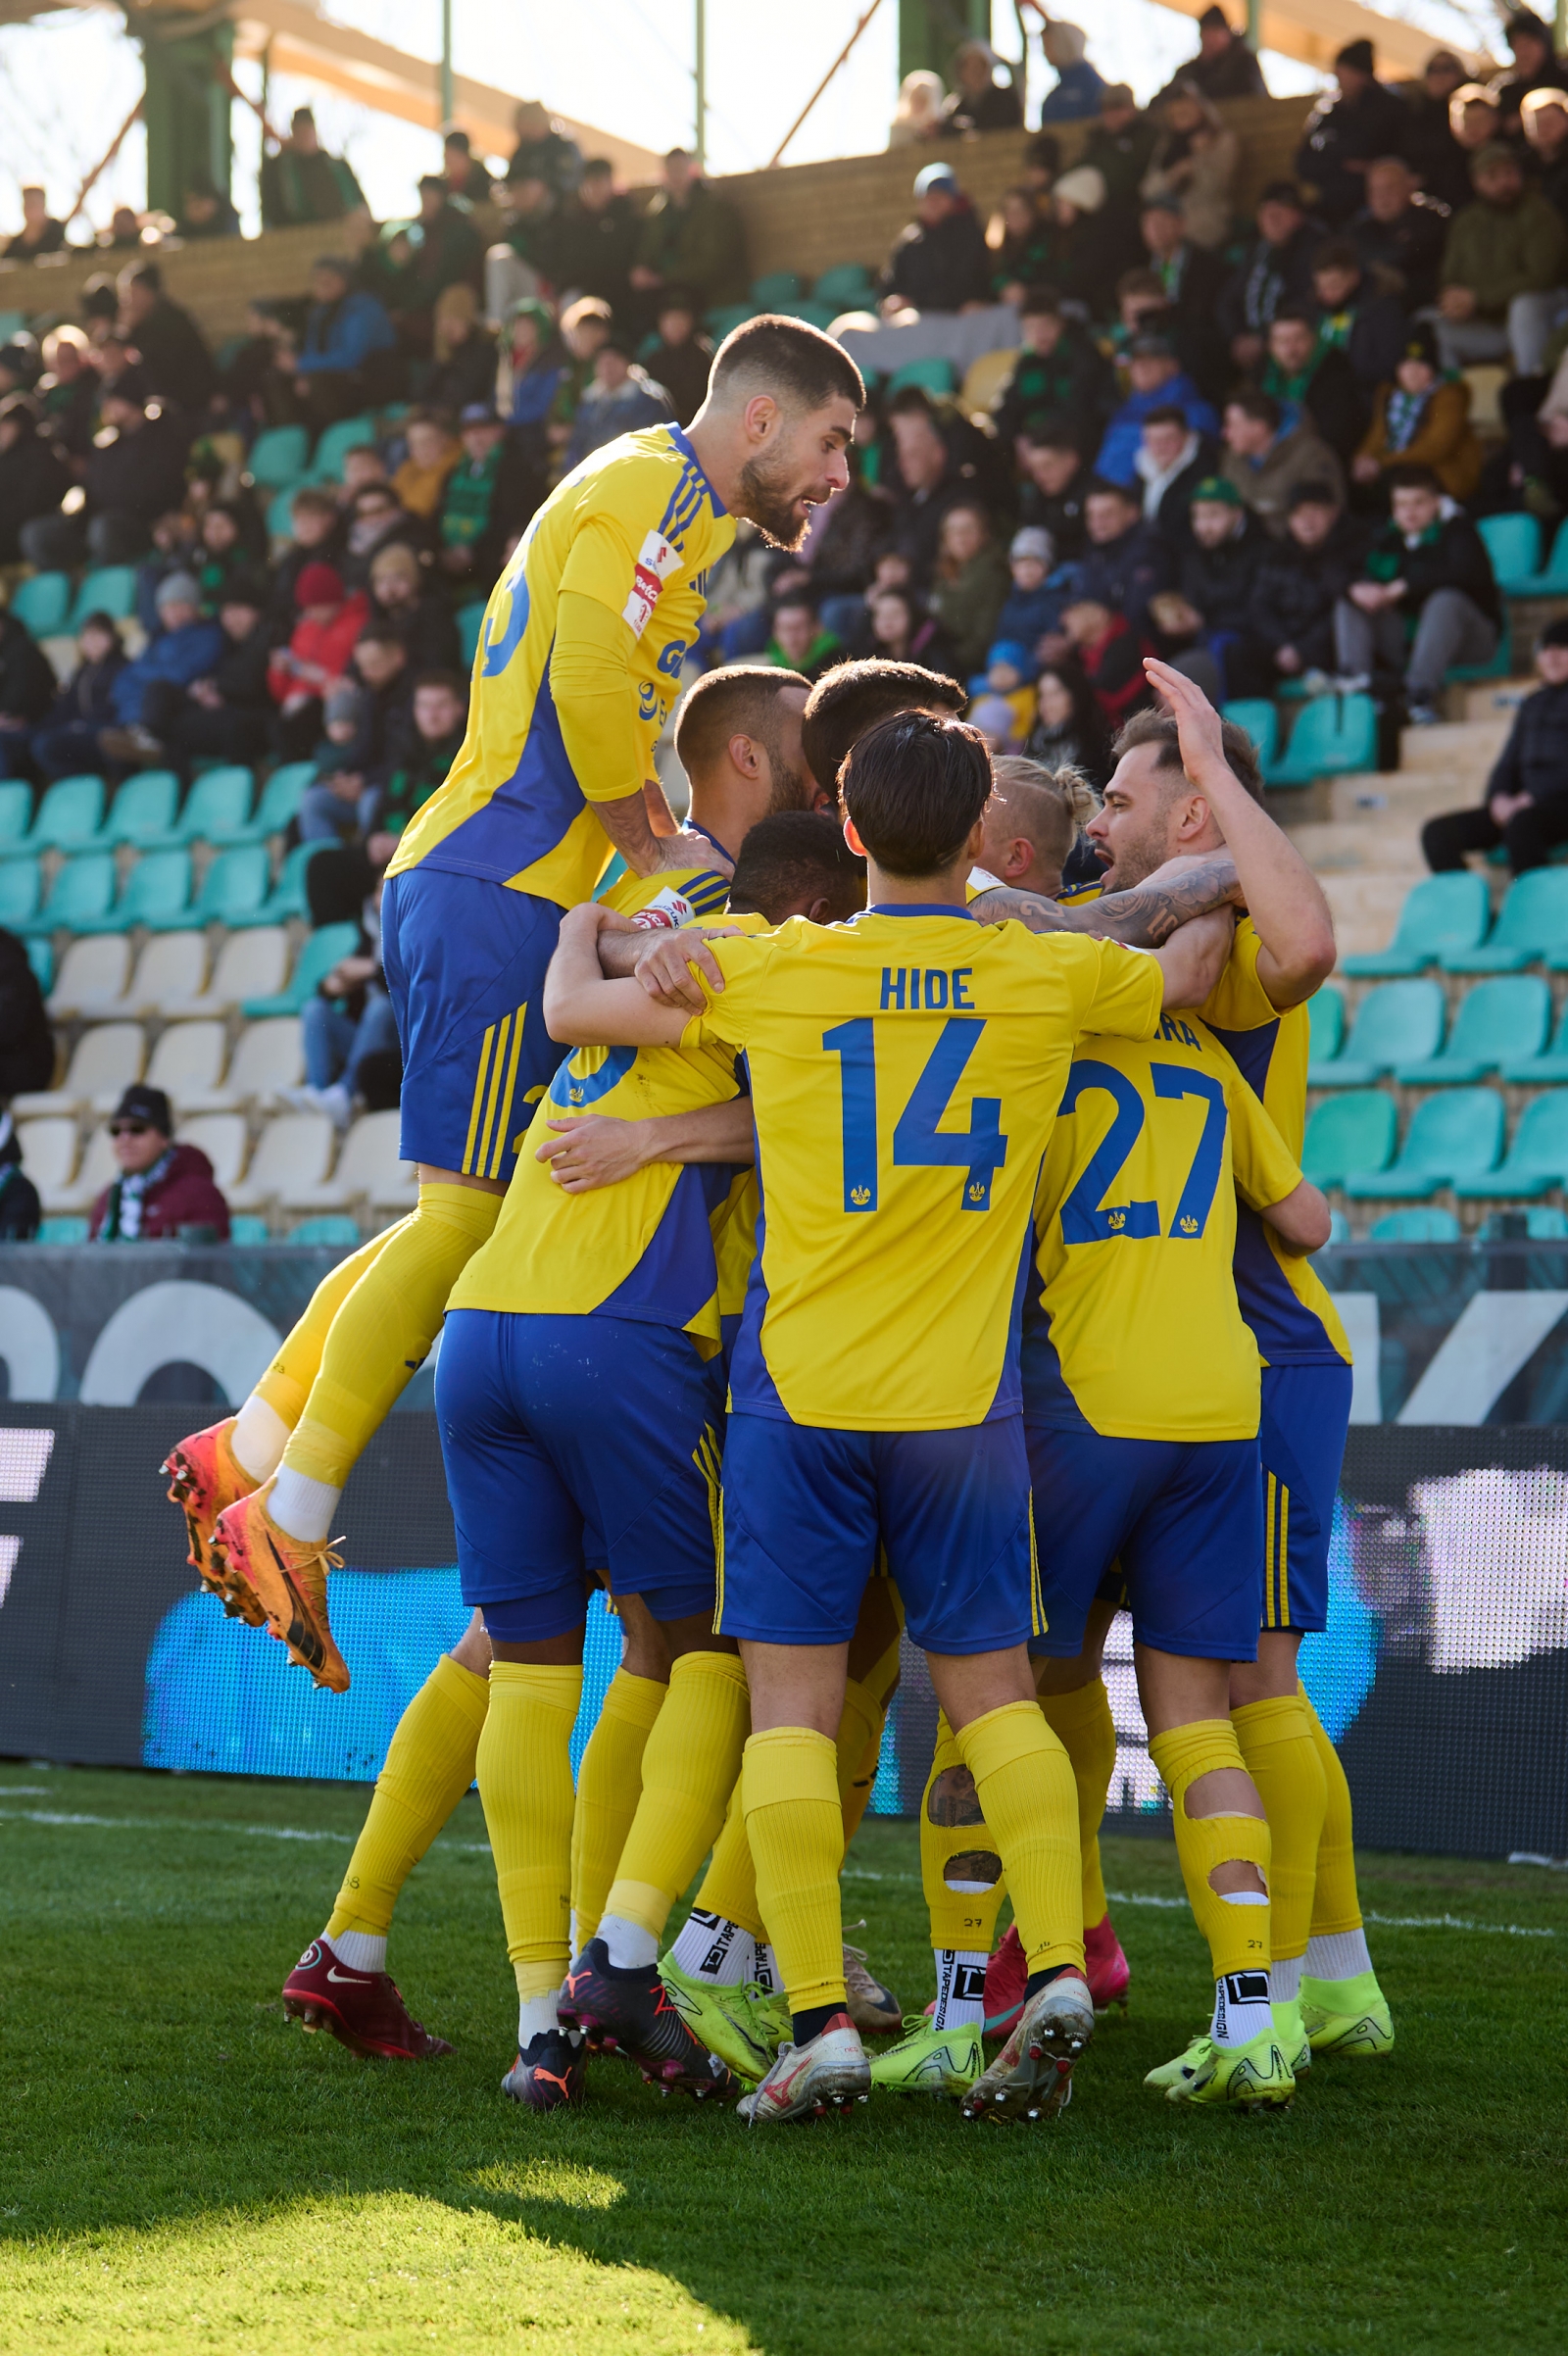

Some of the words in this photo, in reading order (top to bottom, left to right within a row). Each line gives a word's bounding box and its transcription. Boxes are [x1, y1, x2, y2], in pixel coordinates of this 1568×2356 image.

[880, 967, 976, 1010] HIDE
[822, 1016, 1008, 1213] 14
[1056, 1059, 1229, 1246] 27
[1247, 1939, 1263, 1949] 27
